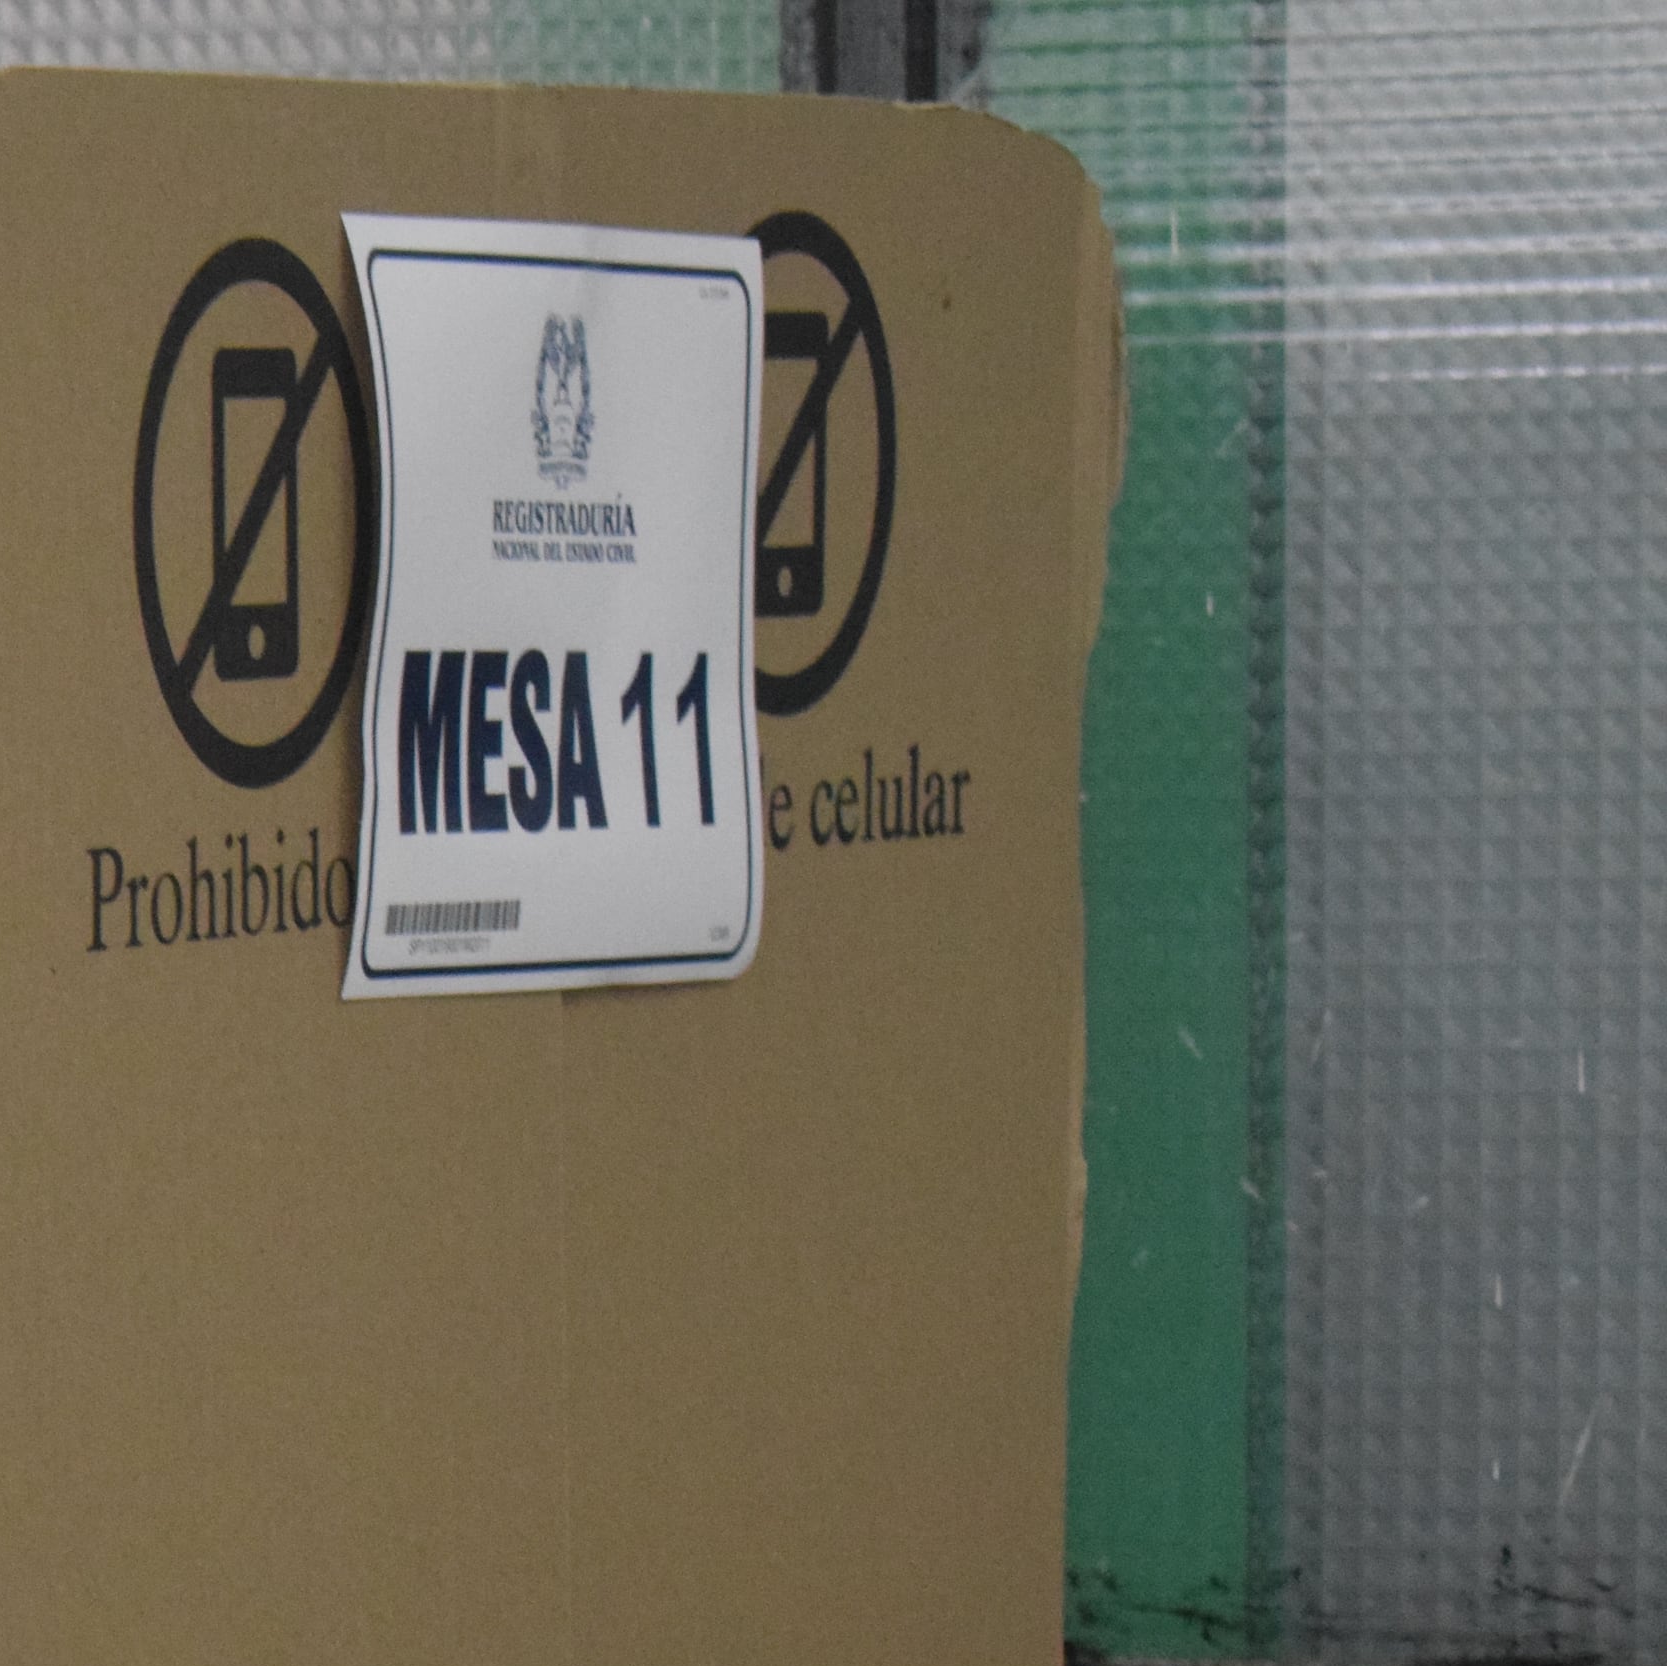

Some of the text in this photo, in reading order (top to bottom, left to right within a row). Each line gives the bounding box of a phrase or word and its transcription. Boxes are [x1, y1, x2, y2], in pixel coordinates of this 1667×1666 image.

[492, 492, 637, 537] REGISTRADURÍA
[396, 647, 716, 835] MESA 11
[809, 742, 972, 847] celular
[85, 824, 357, 952] Prohibido
